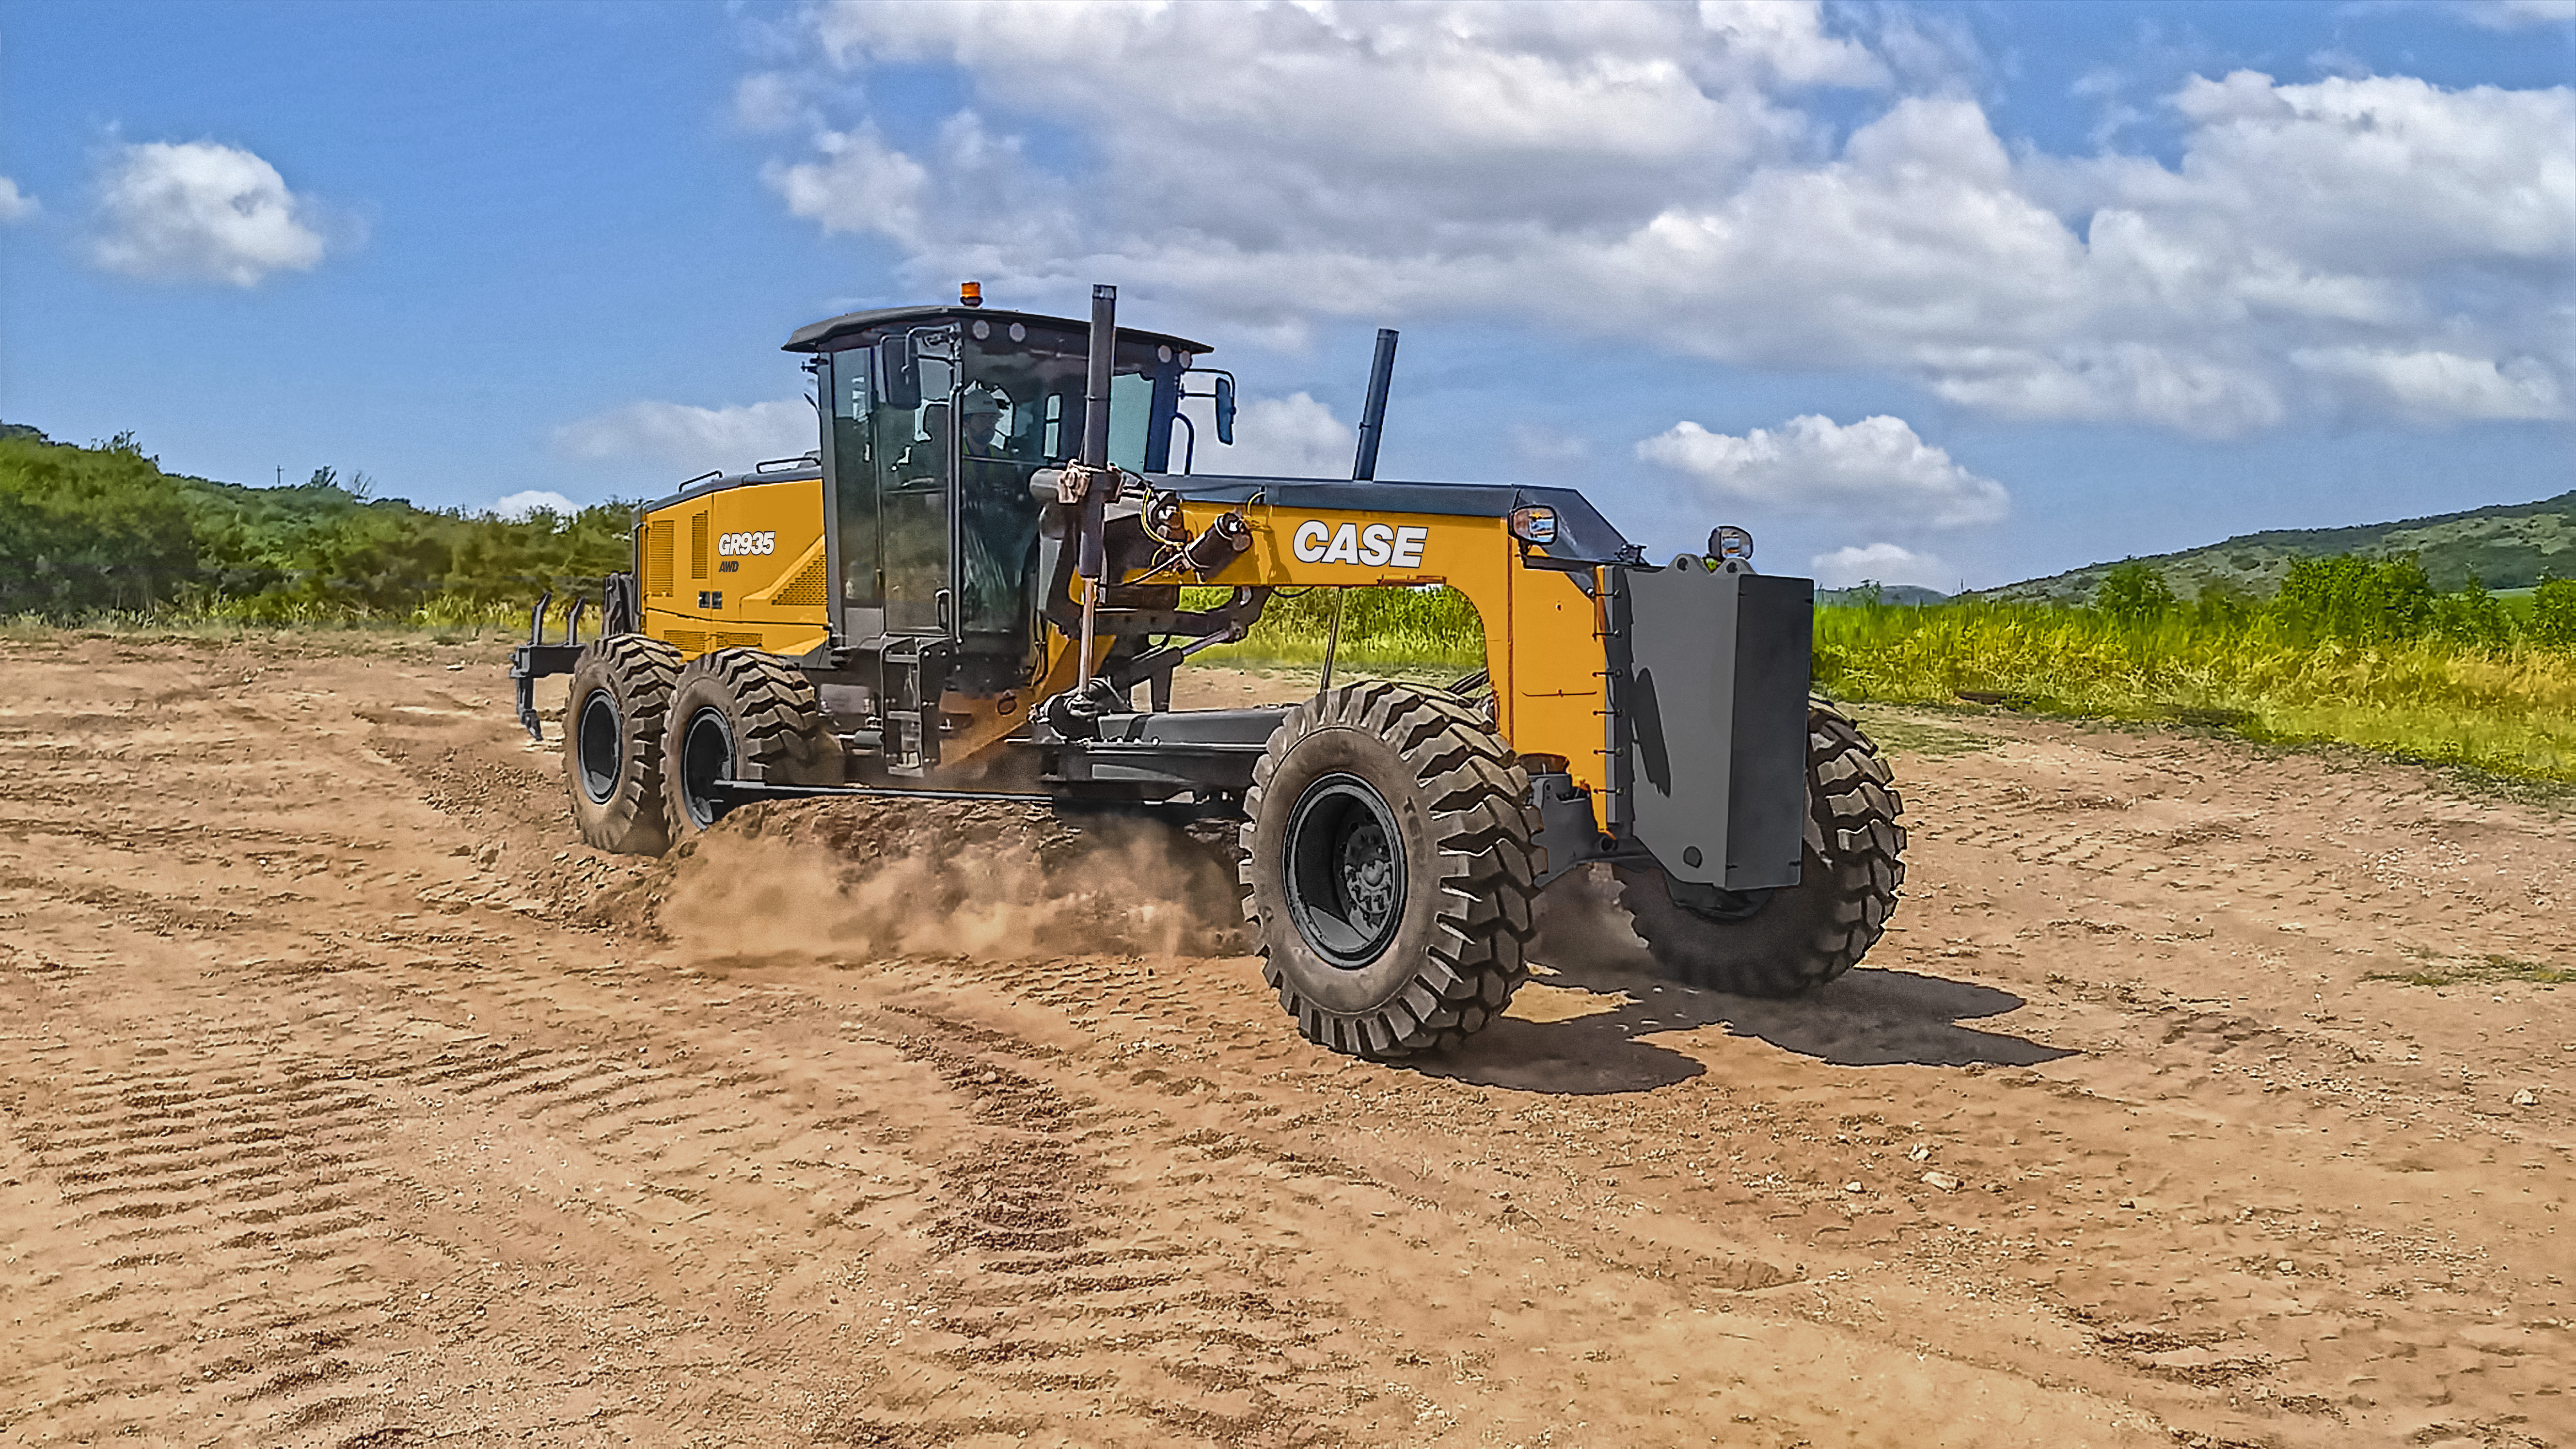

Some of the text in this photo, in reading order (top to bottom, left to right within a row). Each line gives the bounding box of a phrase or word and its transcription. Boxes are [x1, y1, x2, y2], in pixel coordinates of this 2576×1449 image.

[718, 531, 776, 556] GR935
[1293, 520, 1429, 568] CASE
[719, 561, 739, 573] AWD
